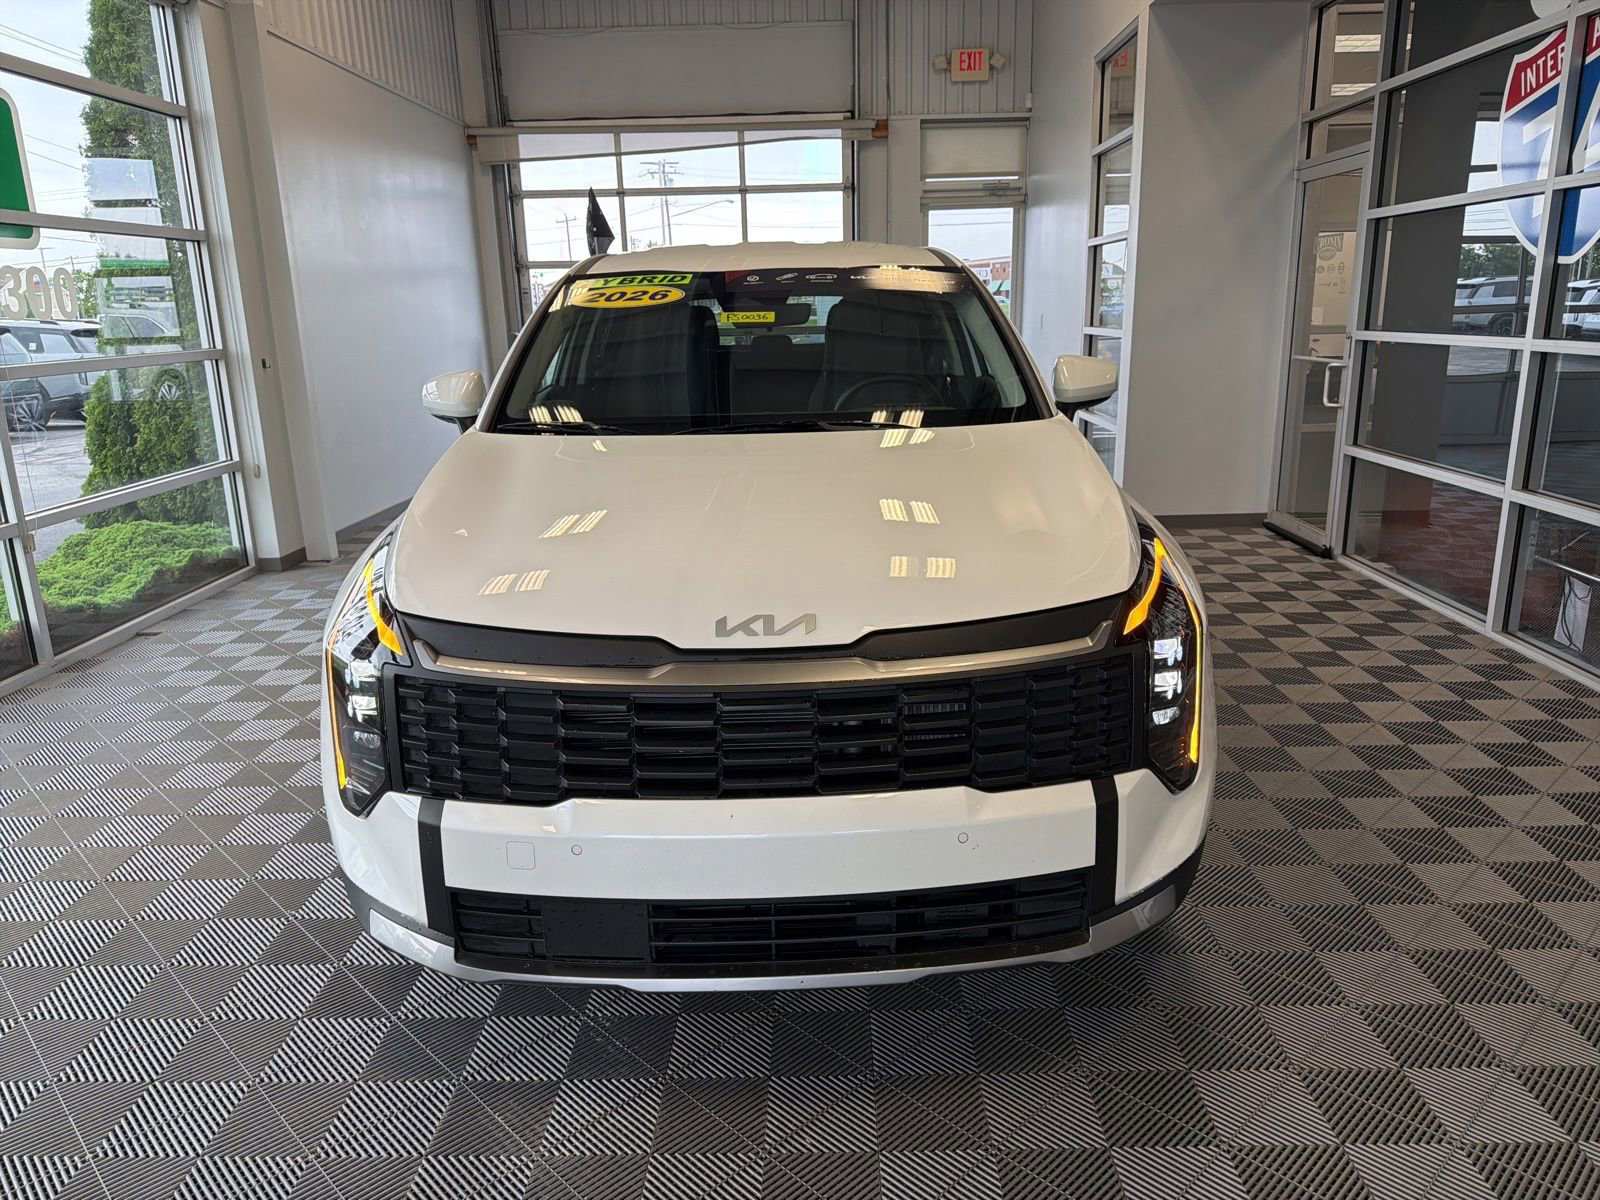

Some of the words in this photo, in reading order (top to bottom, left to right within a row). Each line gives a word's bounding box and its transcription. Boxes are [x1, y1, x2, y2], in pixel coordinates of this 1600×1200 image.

[959, 50, 984, 72] EXIT
[579, 274, 687, 288] YBRID
[582, 289, 673, 303] 2026
[715, 613, 817, 637] KIA
